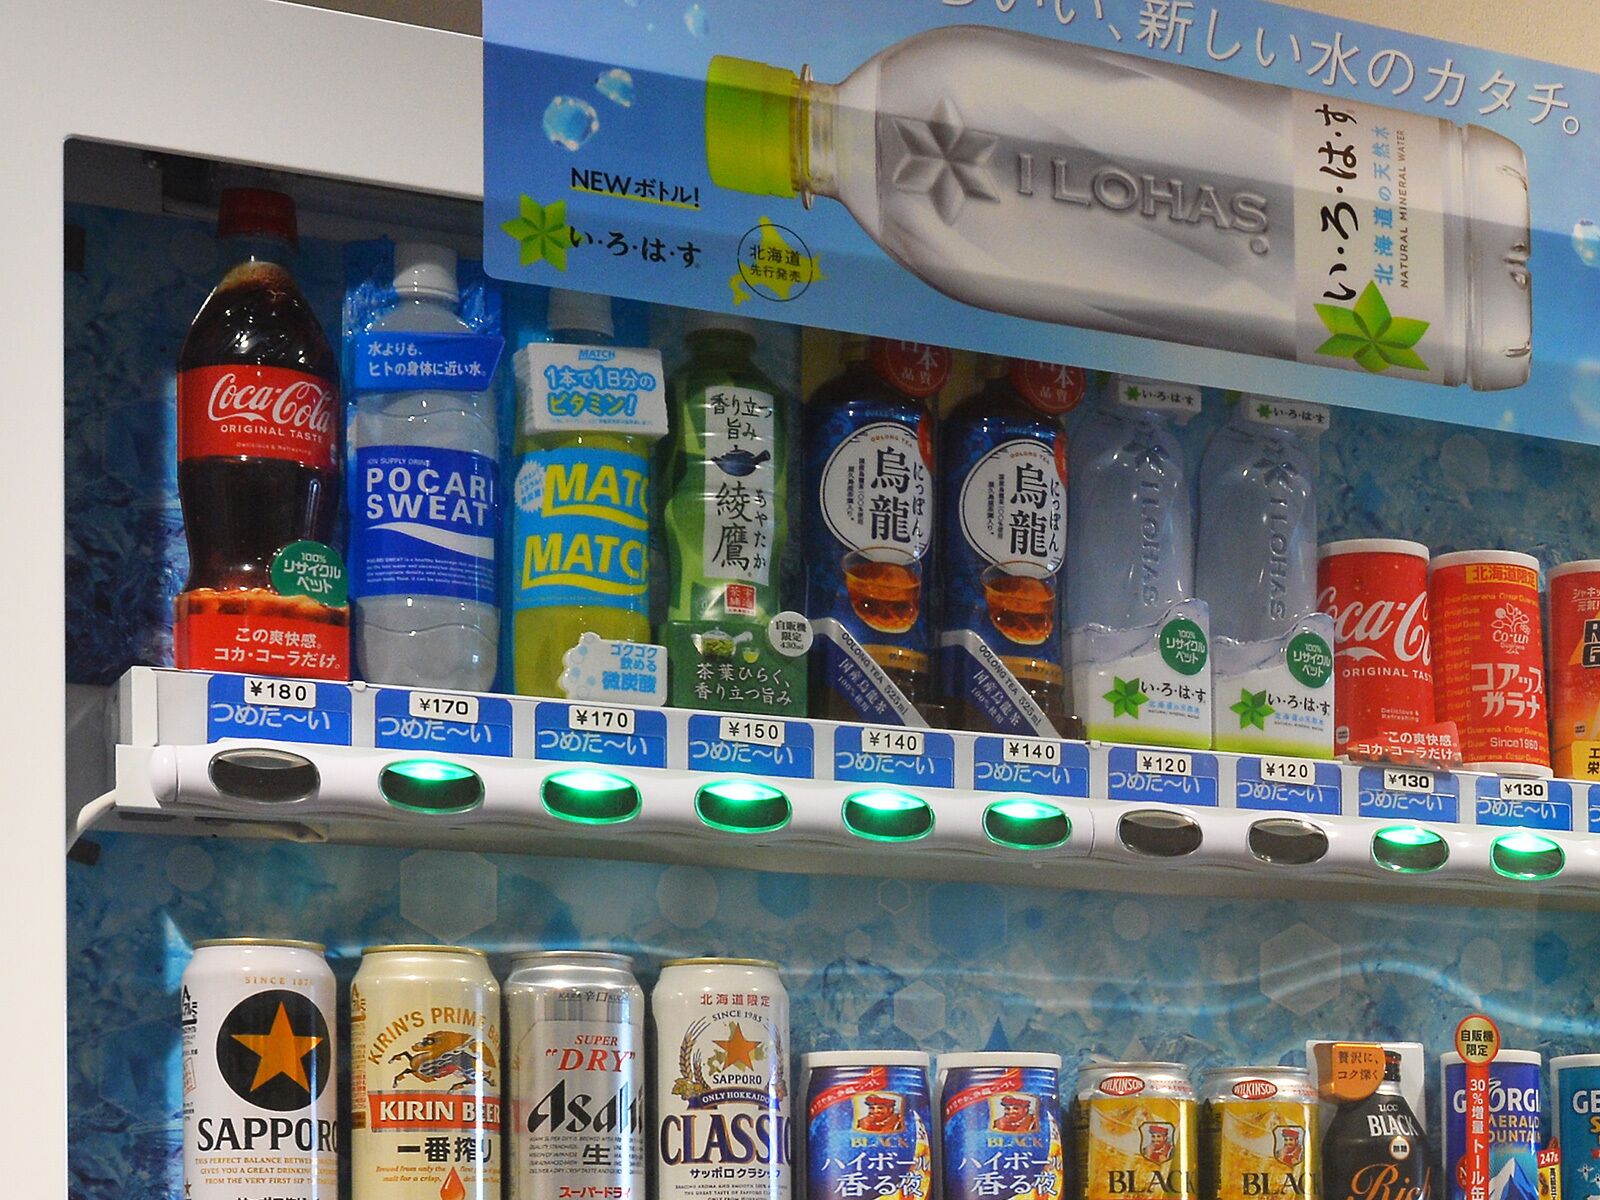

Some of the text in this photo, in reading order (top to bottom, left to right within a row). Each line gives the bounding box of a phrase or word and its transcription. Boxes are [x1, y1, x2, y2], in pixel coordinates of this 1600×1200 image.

[941, 0, 1580, 136] い、新しい水のカタチ。
[571, 168, 700, 207] NEW ボトル!
[1371, 125, 1394, 286] 北海道の天然水
[1396, 130, 1409, 288] NATURAL MINERAL WATER
[569, 226, 700, 268] い・ろ・は・す
[749, 245, 800, 266] 北海道
[750, 264, 800, 283] 先行発売
[368, 342, 423, 358] 水よりも、
[579, 349, 616, 361] MATCH
[368, 361, 487, 378] ヒトの身体に近い水。
[545, 364, 656, 391] 1本で1日分の
[207, 373, 330, 433] Coca-Cola
[548, 393, 638, 418] ビタミン!
[711, 393, 774, 421] 香り立つ
[220, 424, 285, 438] ORIGINAL
[726, 417, 757, 440] 旨み
[870, 446, 911, 543] 烏龍
[912, 461, 925, 538] にっぽん
[366, 498, 488, 526] SWEAT
[713, 481, 752, 570] 綾鷹
[752, 487, 768, 570] あやたか
[301, 551, 326, 563] 100%
[283, 559, 341, 579] リサイクル
[1472, 565, 1538, 588] 北海道限定
[297, 576, 333, 593] ペット
[775, 619, 806, 633] 自販機
[781, 630, 803, 643] 限定
[235, 627, 322, 650] この爽快感。
[214, 647, 341, 670] コカ・コーラだけ。
[602, 673, 656, 693] 微炭酸
[696, 663, 790, 688] 茶葉ひらく、
[250, 681, 308, 702] ¥180
[695, 682, 792, 707] 香り立つ旨み
[1141, 680, 1206, 703] い・ろ・は・す
[420, 698, 469, 717] ¥170
[1267, 692, 1331, 716] い・ろ・は・す
[1482, 692, 1541, 719] ガラナ
[728, 721, 778, 741] ¥150
[868, 732, 917, 751] ¥140
[1143, 755, 1187, 774] ¥120
[1388, 773, 1429, 789] ¥130
[368, 1015, 425, 1066] KIRIN'S
[574, 1034, 618, 1047] SUPER
[1338, 1050, 1380, 1066] 贅沢に、
[712, 1073, 762, 1086] SAPPORO
[1100, 1076, 1144, 1094] WILKINSON
[1337, 1067, 1379, 1082] コク深く
[380, 1099, 454, 1123] KIRIN
[1470, 1078, 1487, 1136] 30%増量
[397, 1136, 493, 1163] 一番搾り
[582, 1143, 612, 1167] 生
[821, 1151, 929, 1172] ハイボール
[559, 1185, 632, 1200] スーパードライ
[834, 1172, 924, 1198] 香る夜
